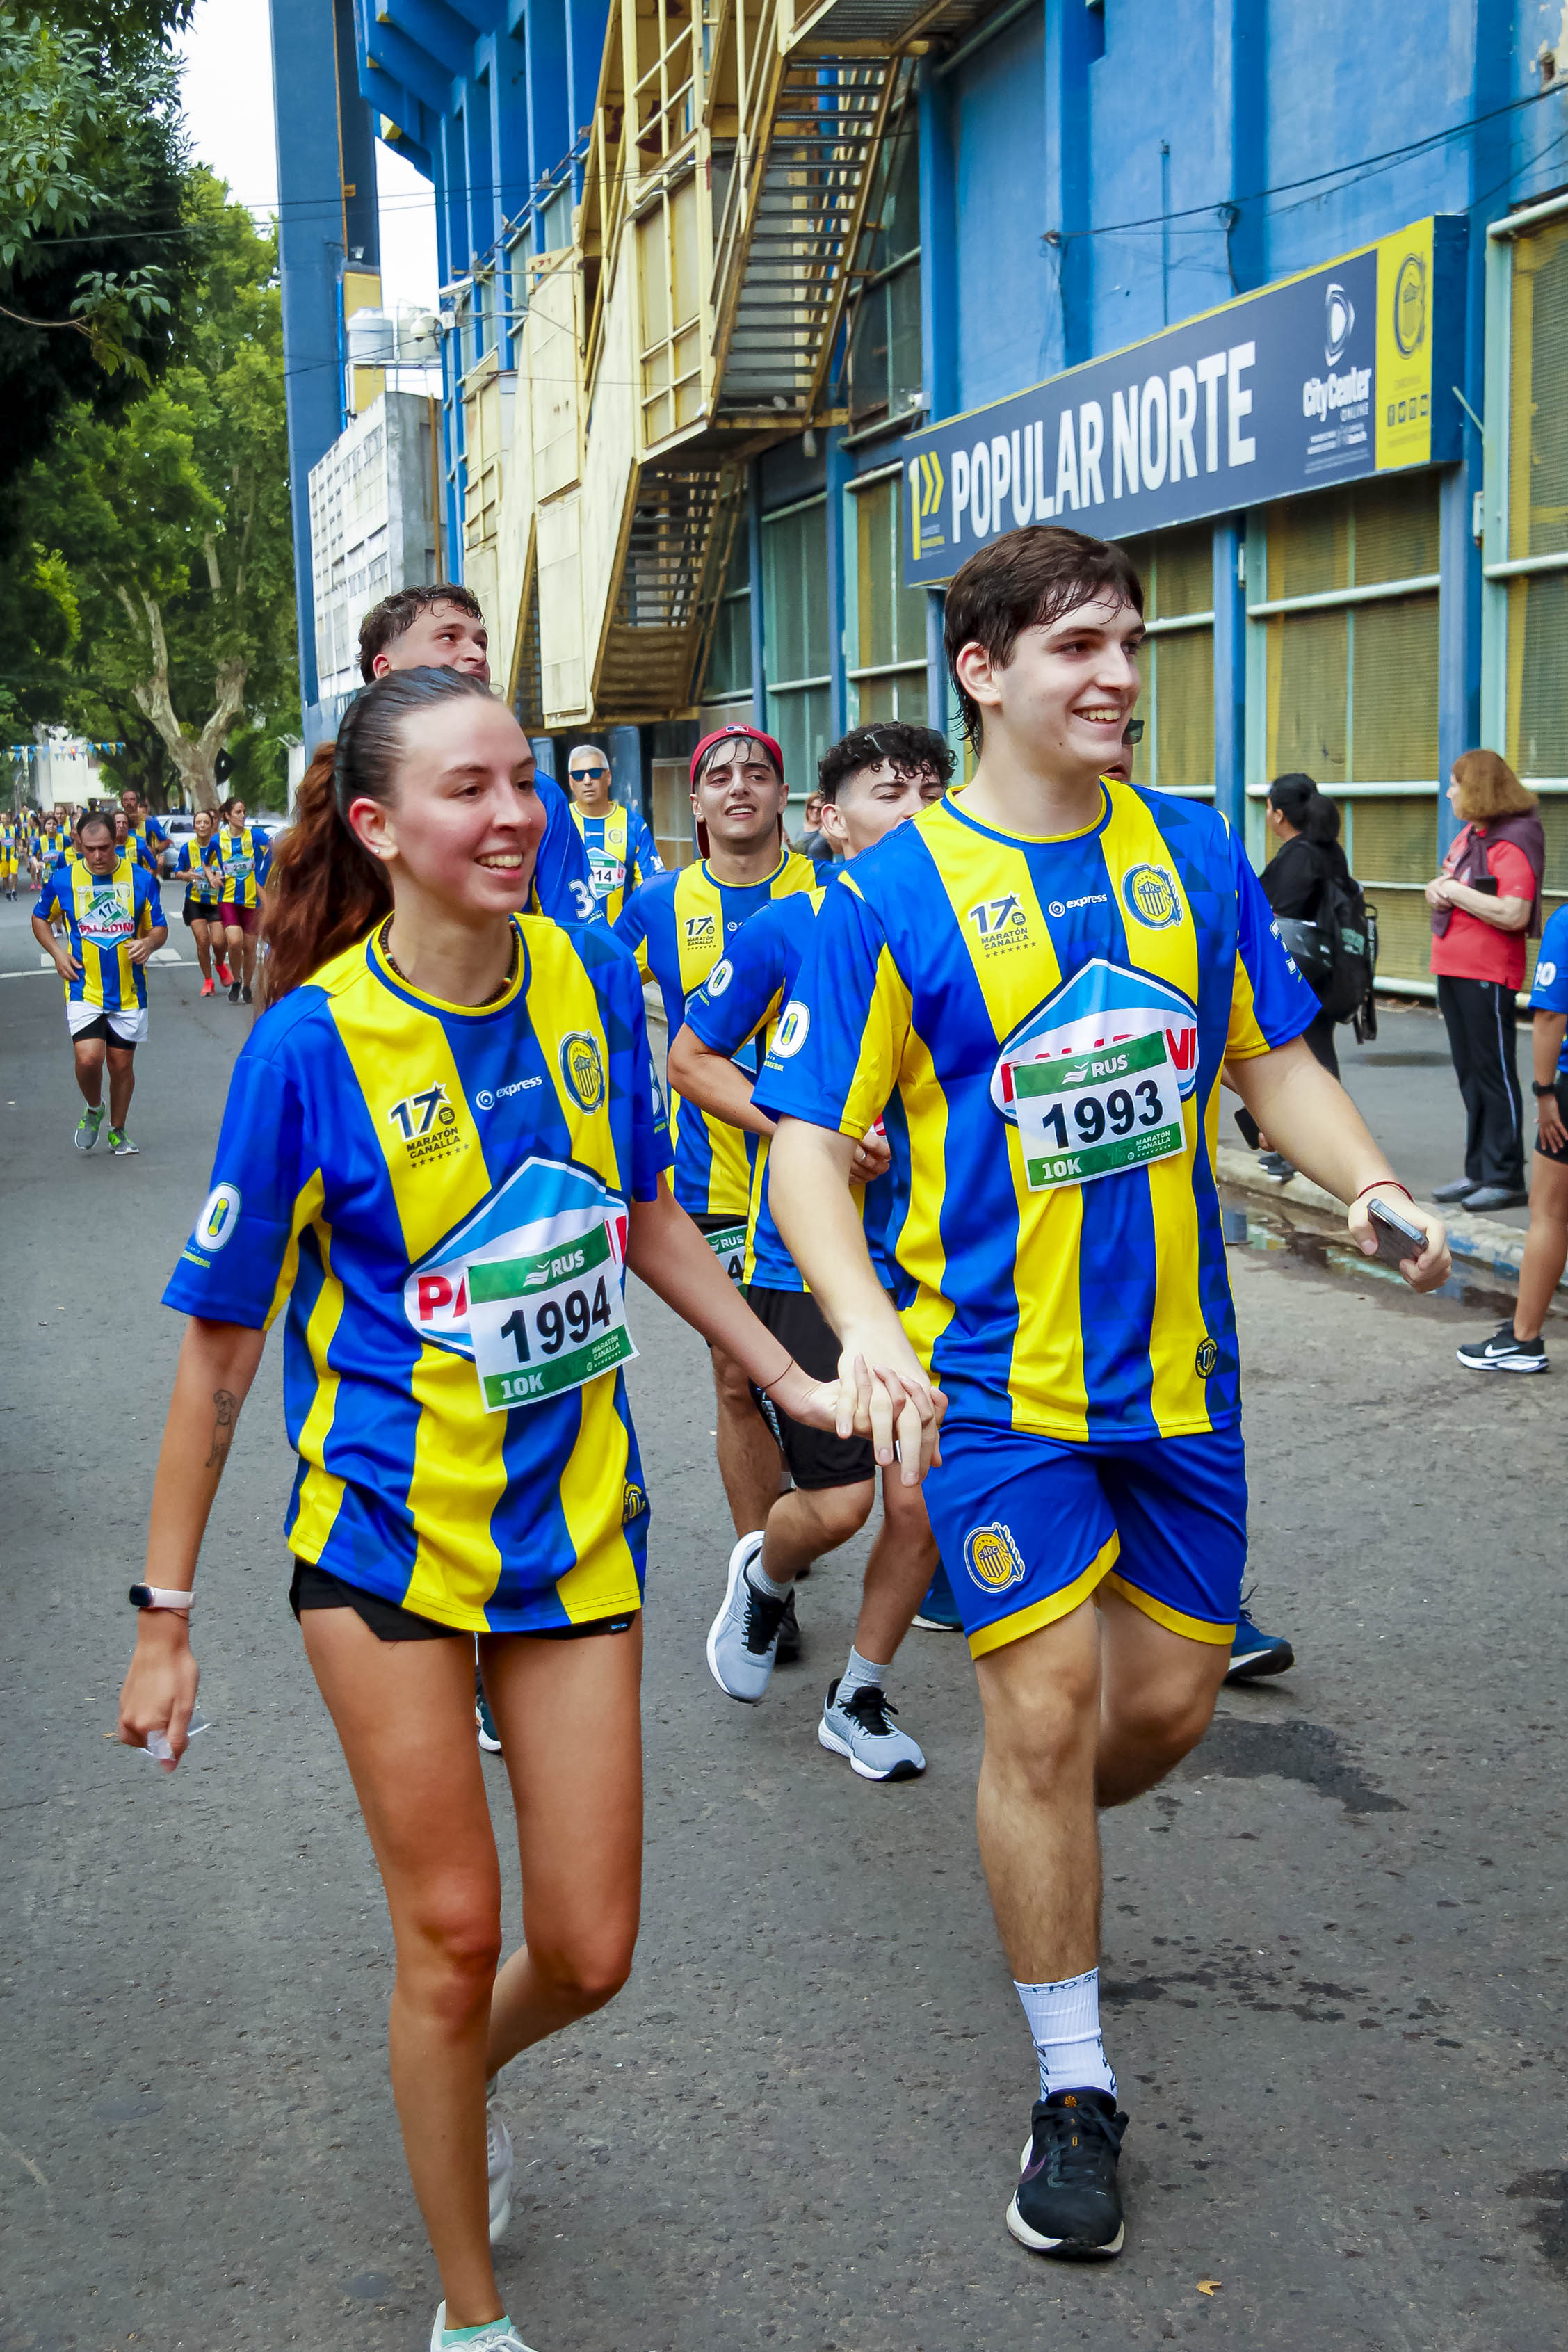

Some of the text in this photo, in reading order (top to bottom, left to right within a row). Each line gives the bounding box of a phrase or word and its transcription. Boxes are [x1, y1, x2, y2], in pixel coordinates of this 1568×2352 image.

[951, 401, 1105, 544] POPULAR
[1113, 341, 1256, 500] NORTE
[1066, 893, 1108, 908] express
[968, 891, 1024, 936] 17
[684, 915, 715, 937] 17
[981, 927, 1028, 944] MARATÓN
[984, 935, 1029, 950] CANALLA
[1091, 1054, 1129, 1078] RUS
[496, 1075, 543, 1098] express
[388, 1079, 451, 1142] 17
[1042, 1079, 1163, 1149] 1993
[406, 1127, 458, 1152] MARATÓN
[410, 1136, 461, 1159] CANALLA
[1135, 1129, 1170, 1146] MARATÓN
[1137, 1136, 1171, 1152] CANALLA
[1042, 1157, 1082, 1179] 10K
[720, 1235, 745, 1248] RUS
[551, 1250, 585, 1278] RUS
[500, 1275, 611, 1364] 1994
[500, 1371, 544, 1399] 10K
[978, 1545, 999, 1558] CARC
